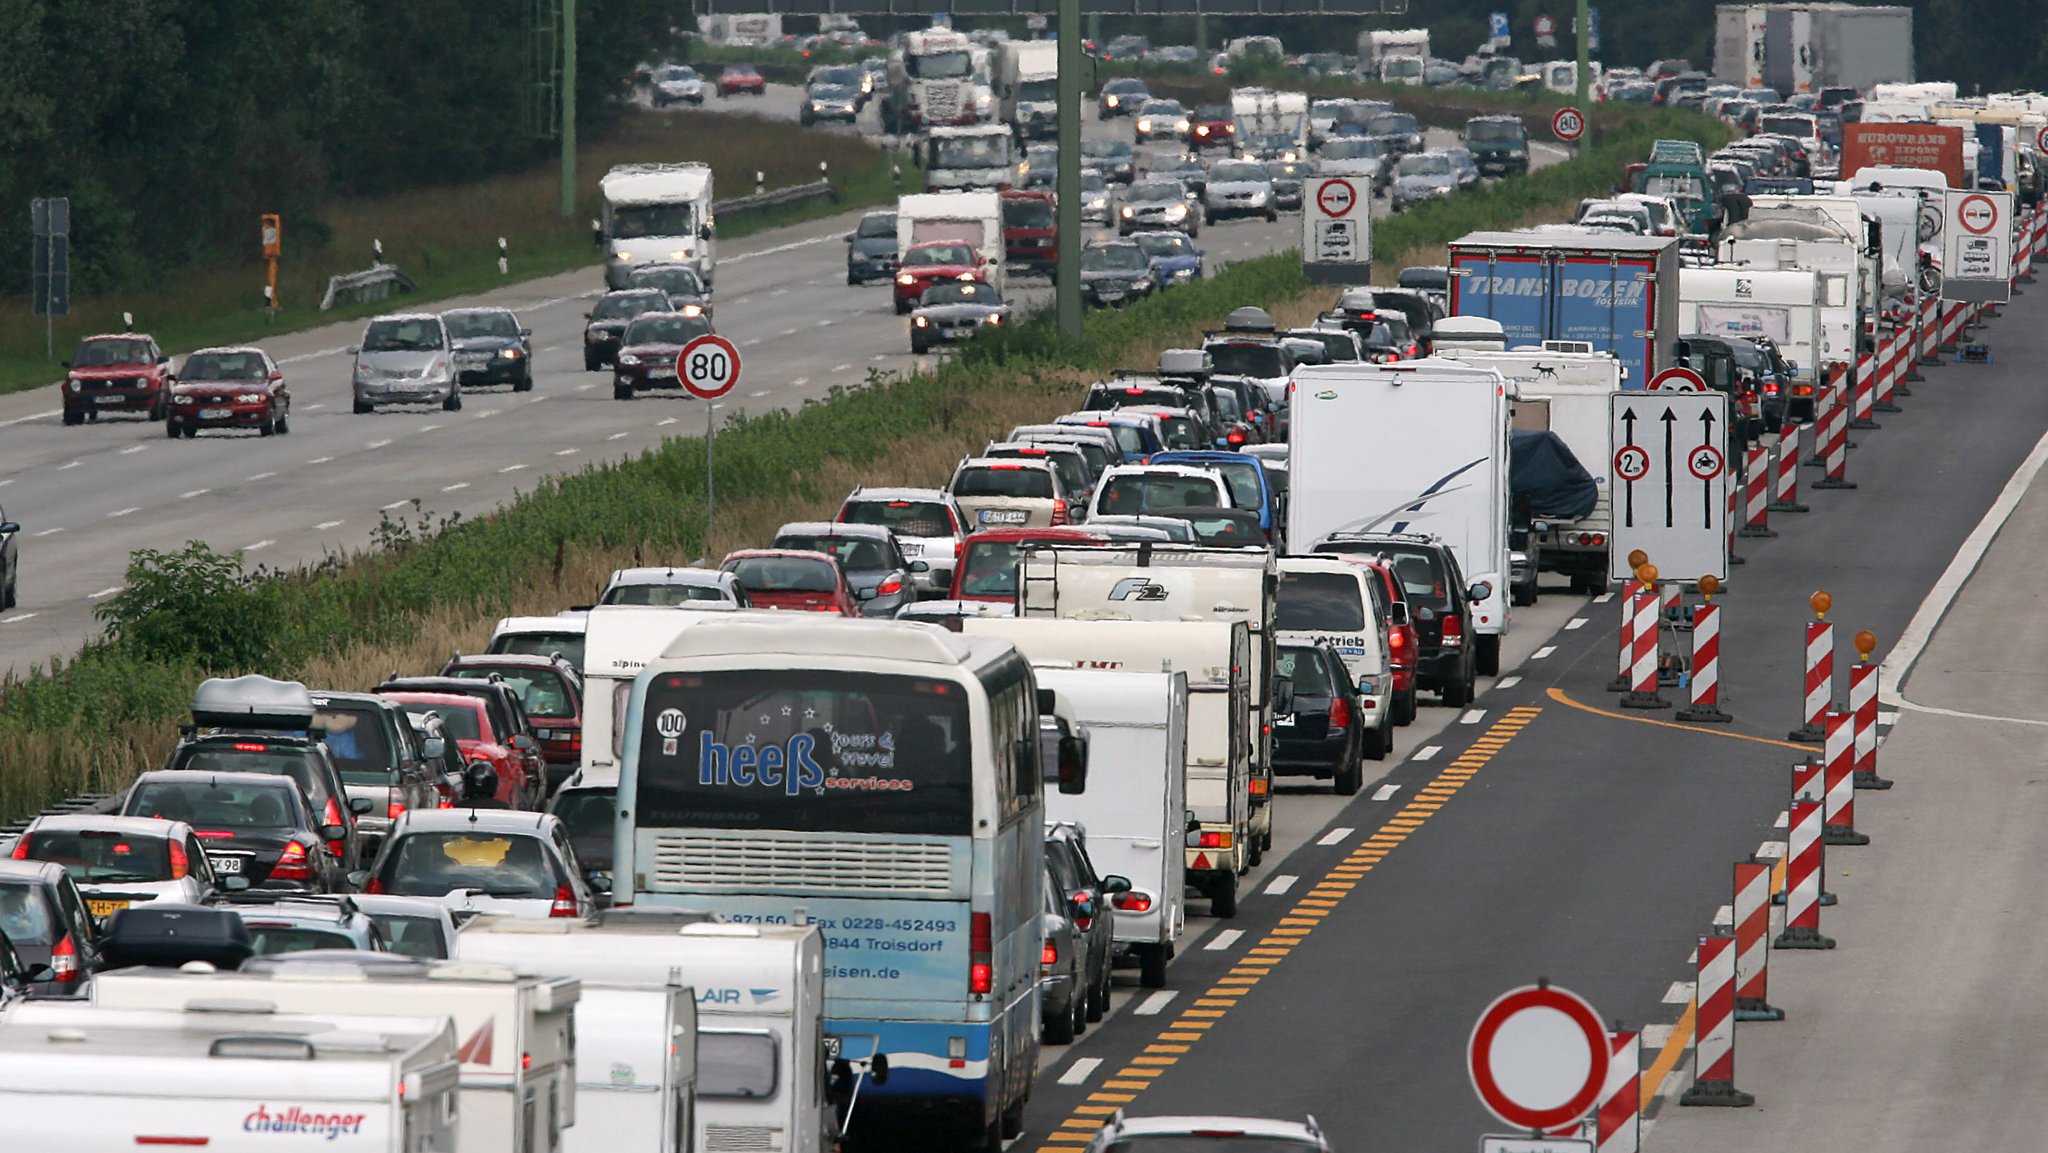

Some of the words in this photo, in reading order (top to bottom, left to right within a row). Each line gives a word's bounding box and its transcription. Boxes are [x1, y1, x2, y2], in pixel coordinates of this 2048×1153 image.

[1491, 15, 1505, 34] P
[1469, 276, 1549, 298] TRANS
[1558, 279, 1645, 299] BOZEN
[1595, 296, 1639, 308] logistik
[691, 352, 726, 381] 80
[1624, 454, 1633, 473] 2
[1108, 577, 1169, 601] F2
[661, 714, 683, 732] 100
[831, 732, 876, 748] tours
[879, 731, 895, 751] &
[700, 731, 824, 795] heeß
[841, 750, 895, 768] travel
[825, 776, 913, 791] services
[806, 917, 836, 929] Fax
[842, 918, 957, 932] 0228-452493
[866, 938, 943, 952] Troisdorf
[243, 1104, 366, 1141] challenger
